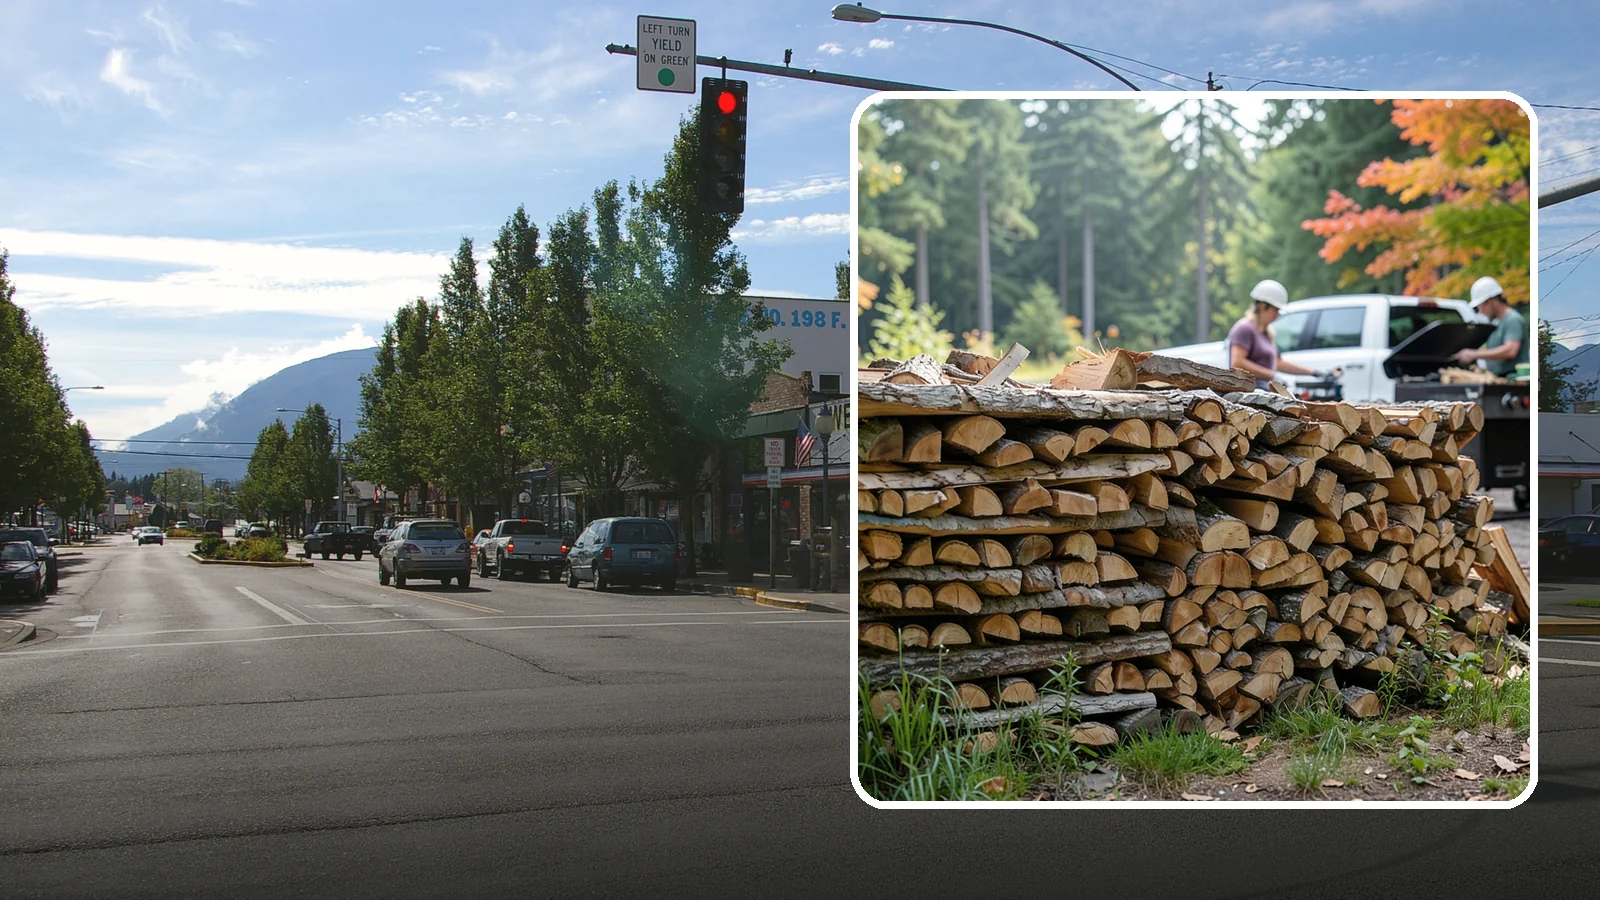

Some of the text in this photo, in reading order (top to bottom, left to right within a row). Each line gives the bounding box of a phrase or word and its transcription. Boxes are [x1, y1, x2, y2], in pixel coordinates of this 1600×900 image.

[643, 23, 690, 36] LEFT TURN
[652, 38, 682, 51] YIELD
[644, 53, 689, 66] ON GREEN
[791, 309, 827, 328] 198
[831, 311, 847, 329] F.
